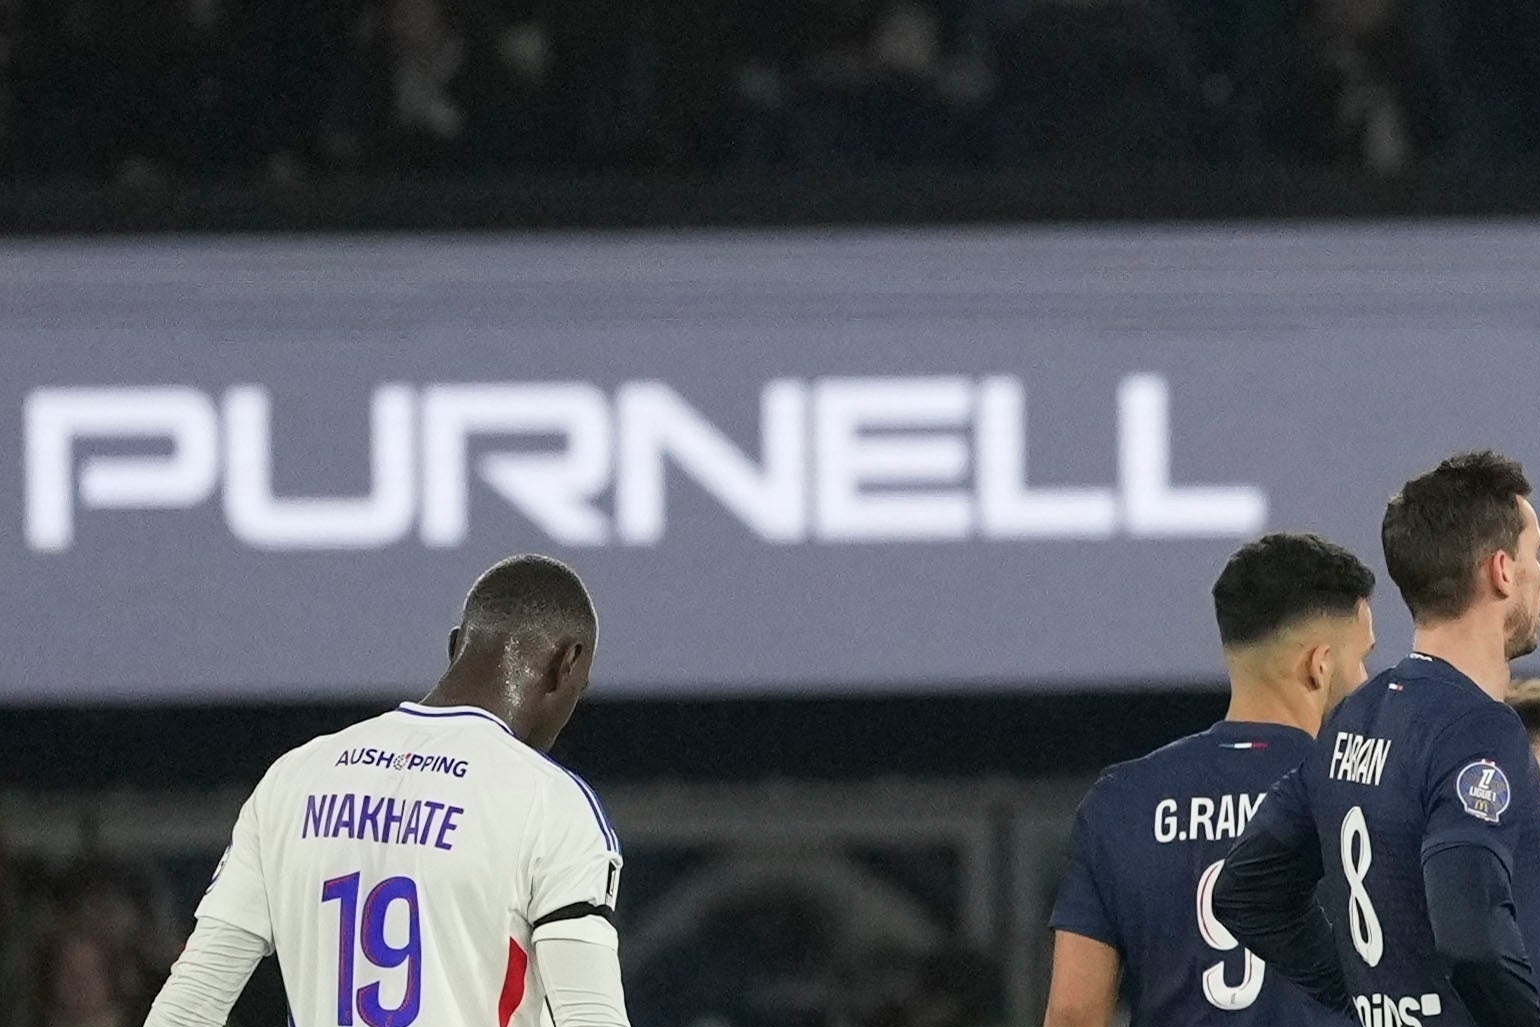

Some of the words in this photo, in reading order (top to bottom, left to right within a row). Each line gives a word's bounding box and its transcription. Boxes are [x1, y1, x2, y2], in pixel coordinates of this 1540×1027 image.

[22, 374, 1268, 552] PURNELL
[302, 793, 465, 851] NIAKHATE
[1340, 806, 1384, 967] 8
